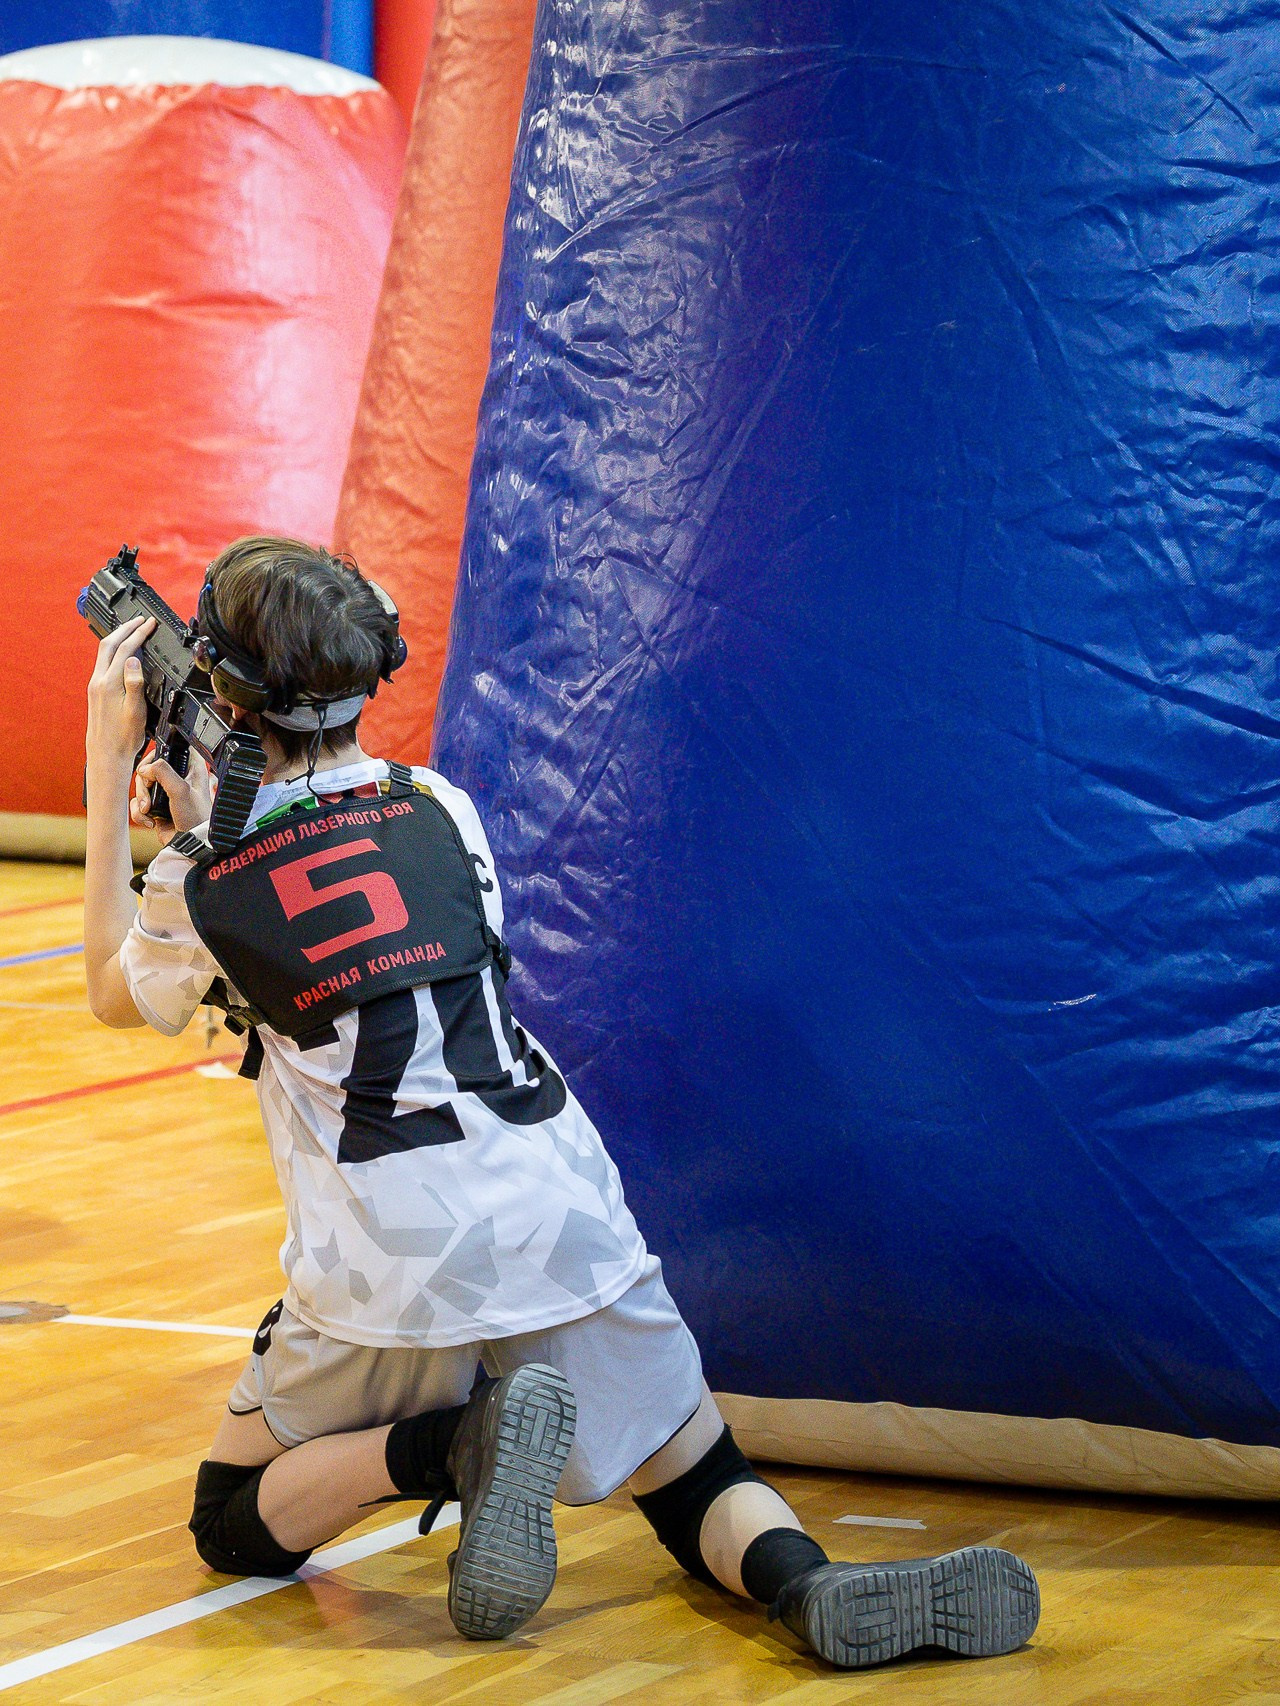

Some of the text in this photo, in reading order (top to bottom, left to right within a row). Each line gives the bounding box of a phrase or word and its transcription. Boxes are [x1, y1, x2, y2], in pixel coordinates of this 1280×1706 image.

[208, 801, 415, 881] ФЕДЕРАЦИЯ ЛАЗЕРНОГО БОЯ
[268, 838, 410, 964] 5
[293, 941, 447, 1012] КРАСНАЯ КОМАНДА
